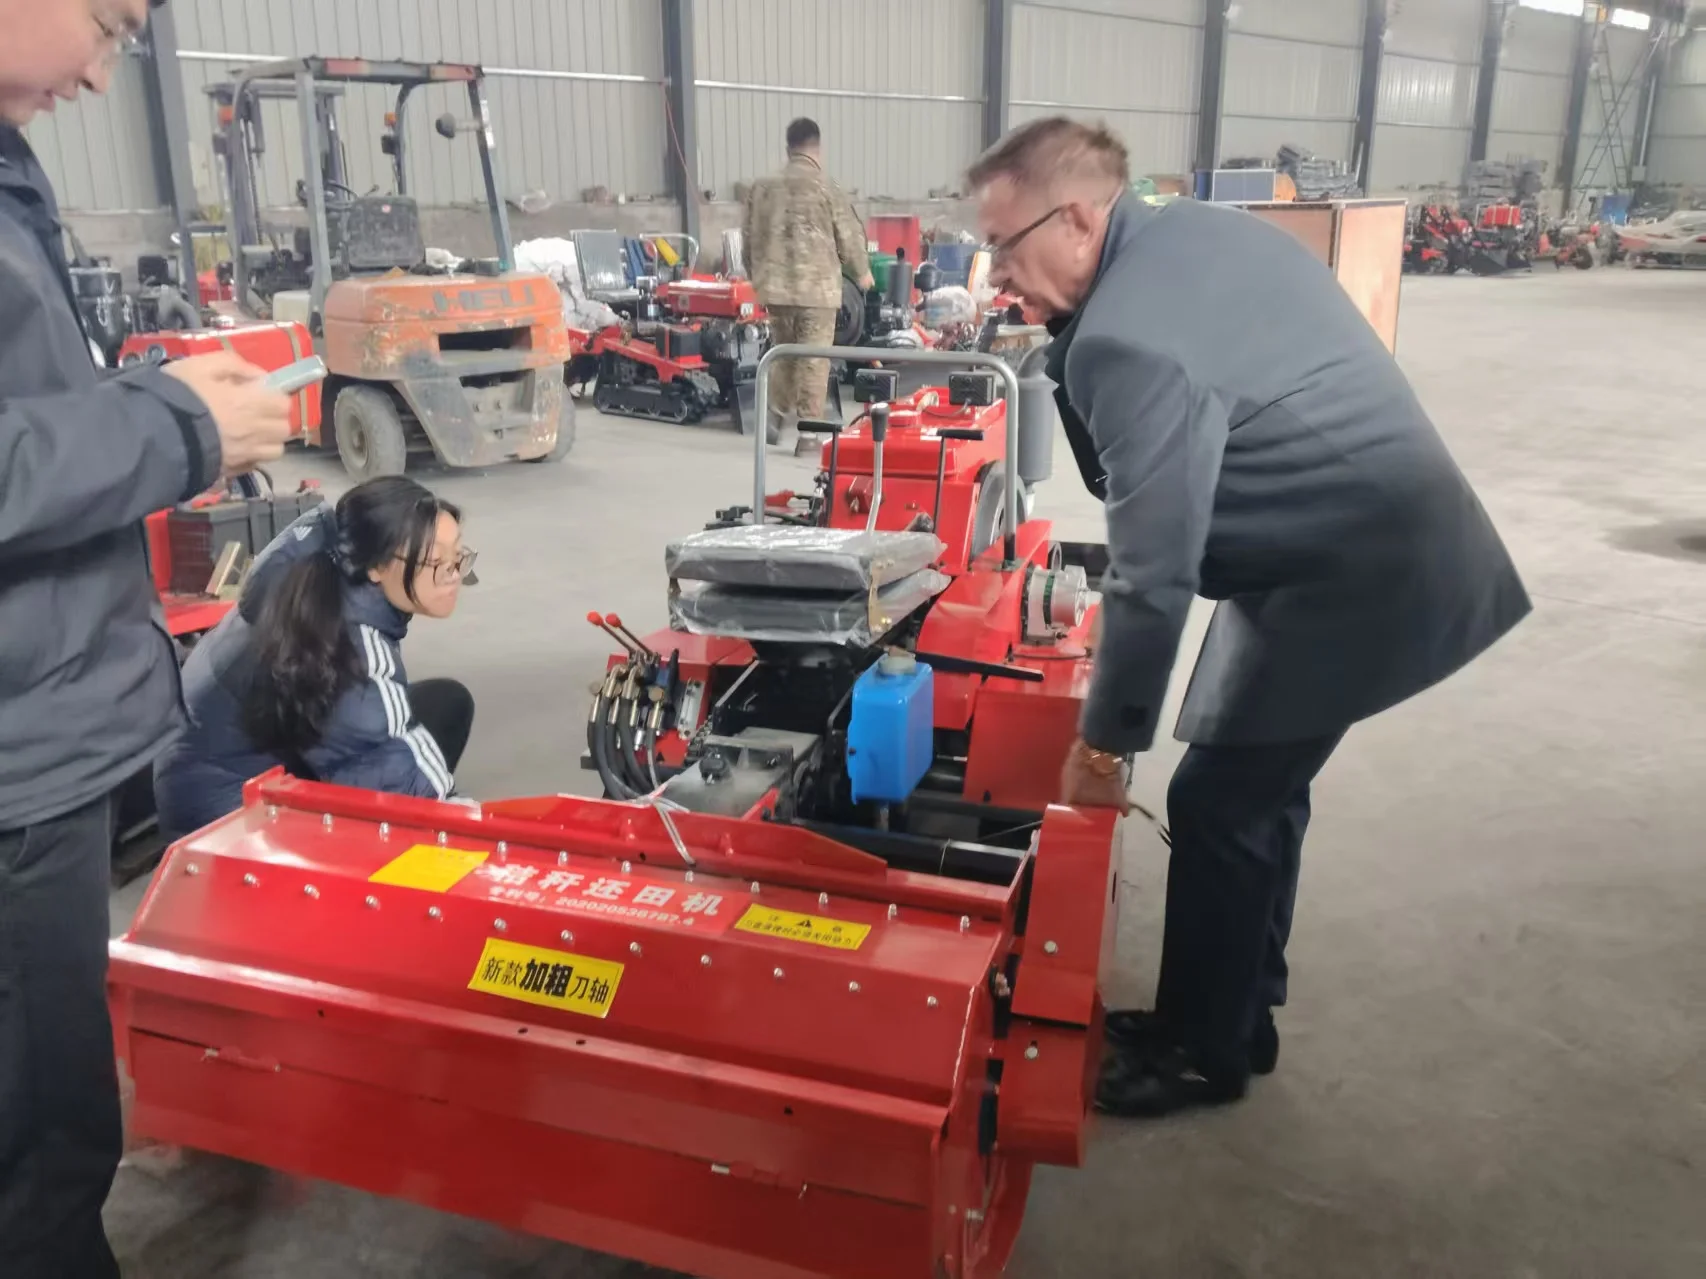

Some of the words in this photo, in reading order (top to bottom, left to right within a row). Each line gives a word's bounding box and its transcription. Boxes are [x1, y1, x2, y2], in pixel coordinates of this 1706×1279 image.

[433, 285, 535, 313] HELI
[482, 956, 610, 1005] 新款加粗刀轴
